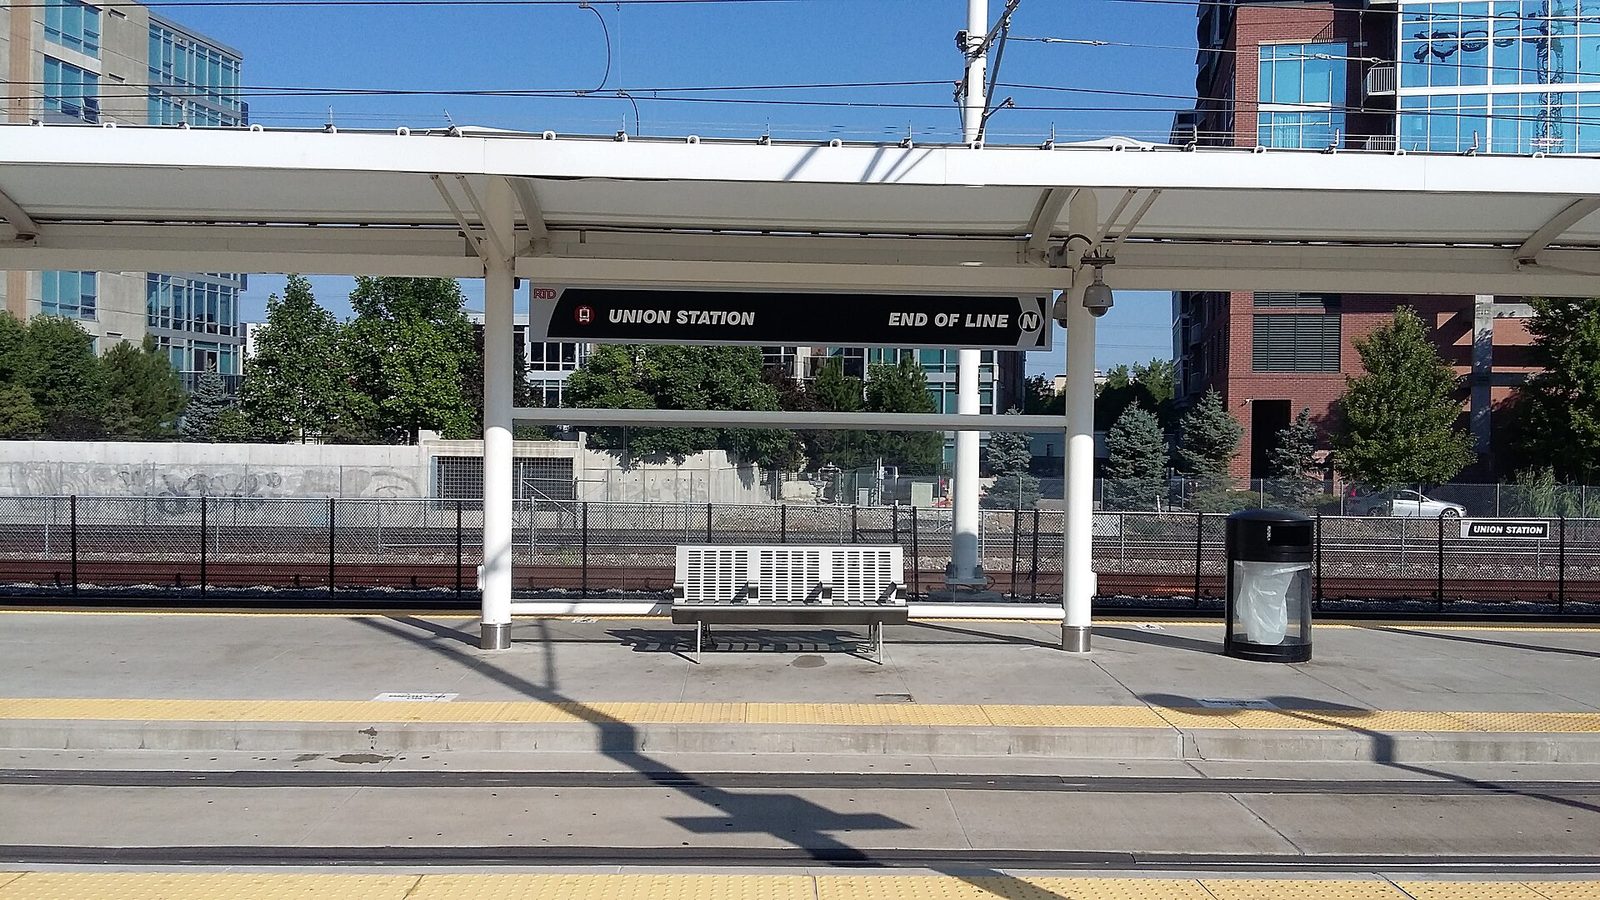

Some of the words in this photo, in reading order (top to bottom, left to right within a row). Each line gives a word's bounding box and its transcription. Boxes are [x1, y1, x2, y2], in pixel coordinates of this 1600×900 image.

[533, 288, 557, 300] RTD
[608, 309, 672, 324] UNION
[676, 310, 755, 326] STATION
[888, 312, 928, 327] END
[934, 312, 960, 328] OF
[964, 314, 1009, 328] LINE
[1022, 314, 1038, 329] N
[1473, 525, 1504, 534] UNION
[1505, 526, 1543, 535] STATION
